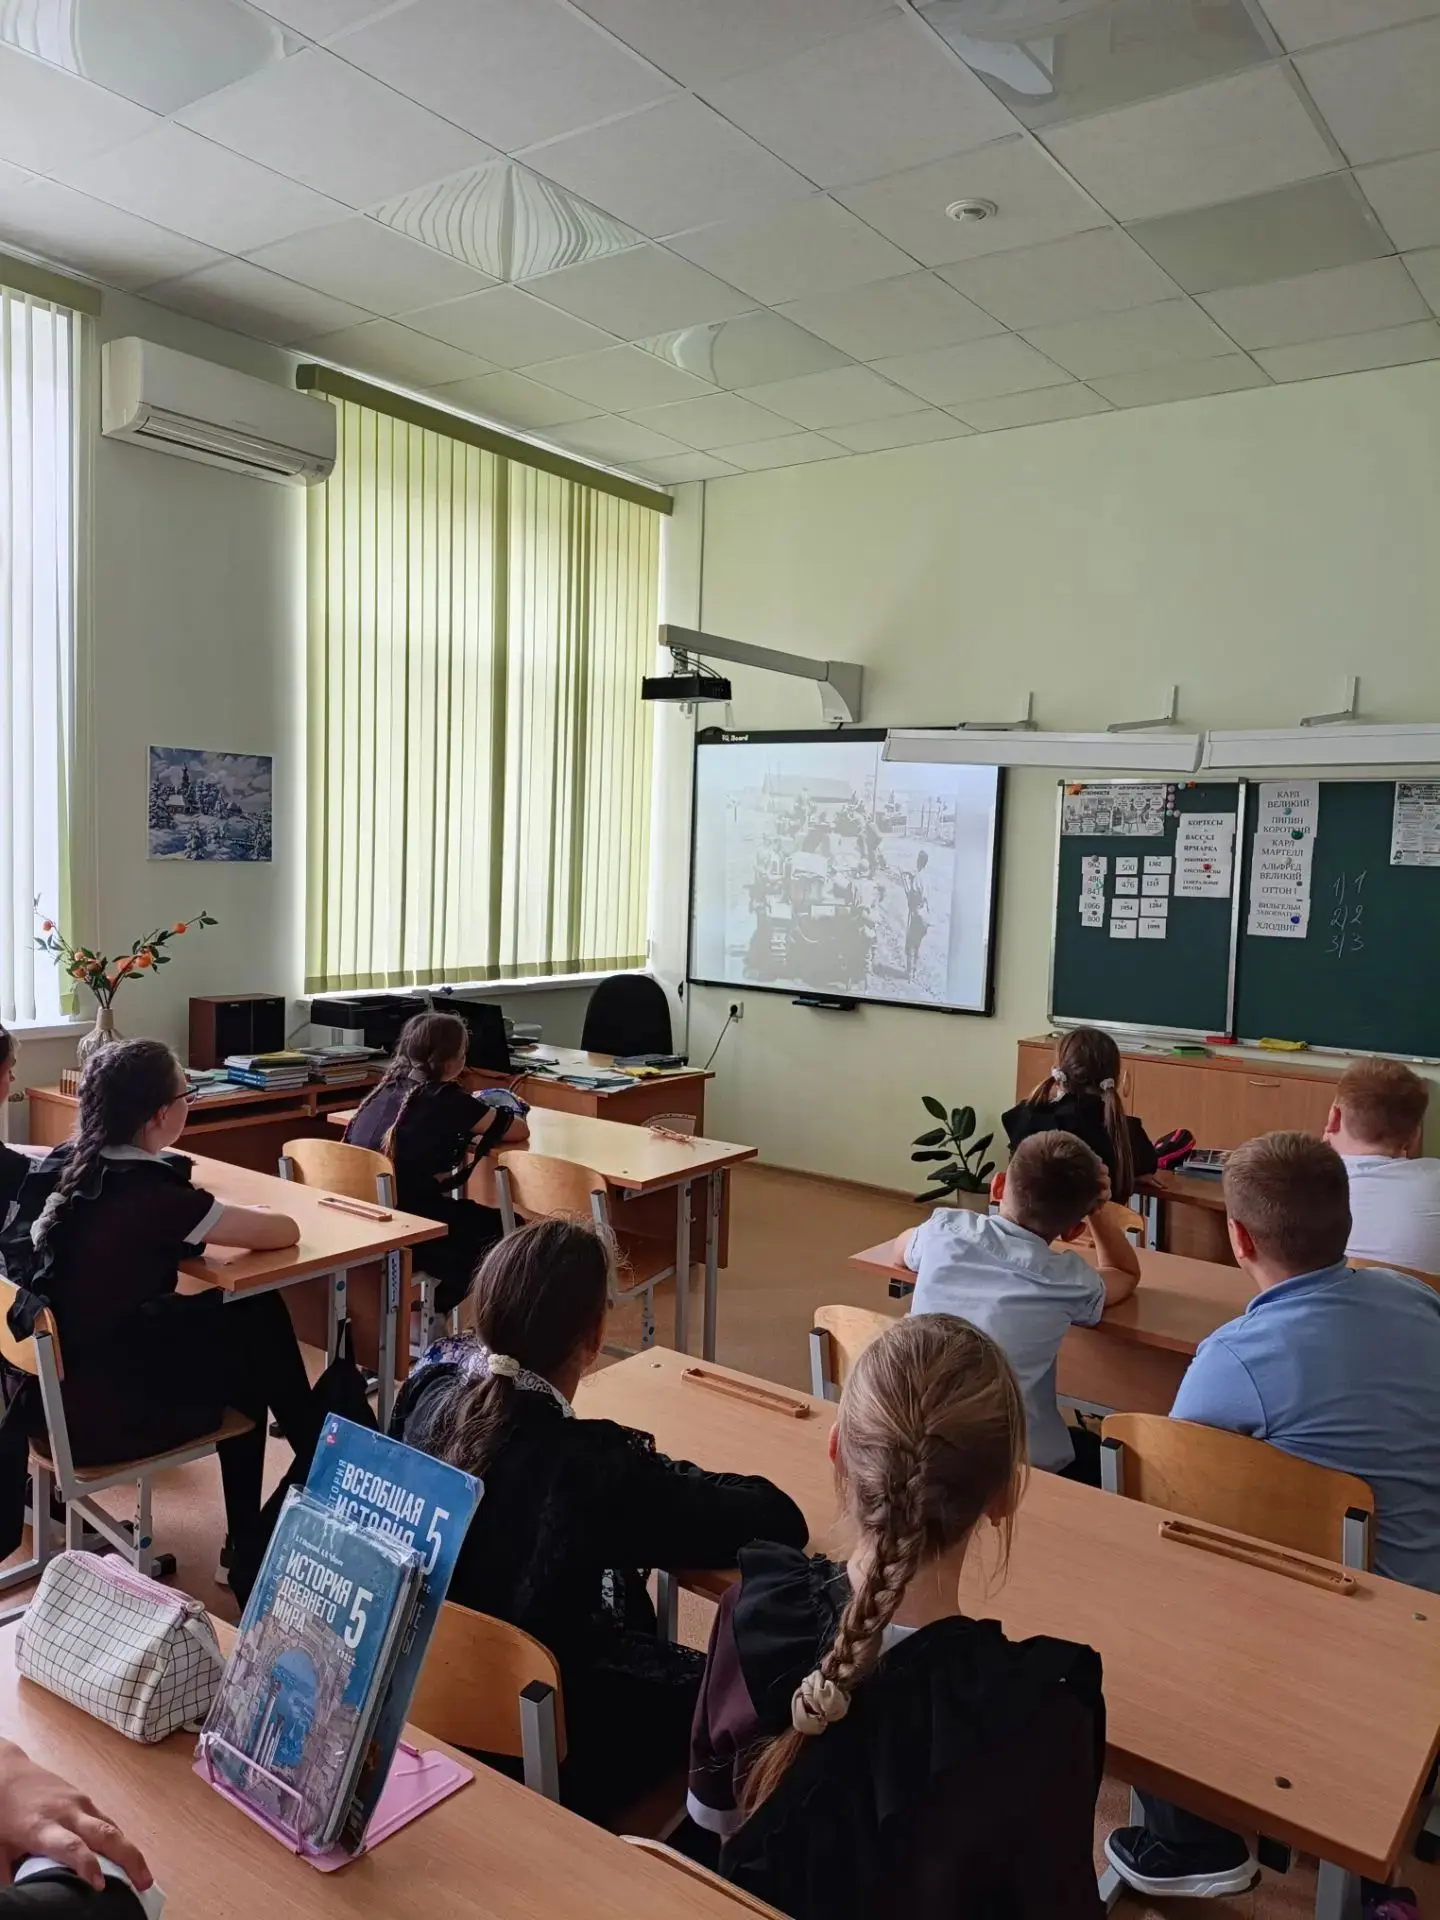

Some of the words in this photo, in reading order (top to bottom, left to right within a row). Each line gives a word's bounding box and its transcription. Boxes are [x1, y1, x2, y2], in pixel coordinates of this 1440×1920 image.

[1277, 791, 1300, 799] КАРЛ
[1267, 798, 1310, 808] ВЕЛИКИЙ
[1188, 819, 1224, 828] КОРТЕСЫ
[1271, 839, 1296, 848] КАРЛ
[1261, 848, 1304, 857] МАРТЕЛЛ
[1260, 863, 1302, 872] АЛЬФРЕД
[1259, 872, 1302, 881] ВЕЛИКИЙ
[1261, 886, 1292, 895] ОТТОН
[1256, 921, 1298, 932] ХЛОДВИГ
[326, 1458, 348, 1510] СТОРИЯ
[341, 1461, 426, 1528] ВСЕОБЩАЯ
[423, 1506, 450, 1577] 5
[285, 1548, 353, 1606] ИСТОРИЯ
[276, 1575, 338, 1625] ДРЕВНЕГО
[271, 1597, 306, 1634] МИРА
[343, 1586, 374, 1650] 5
